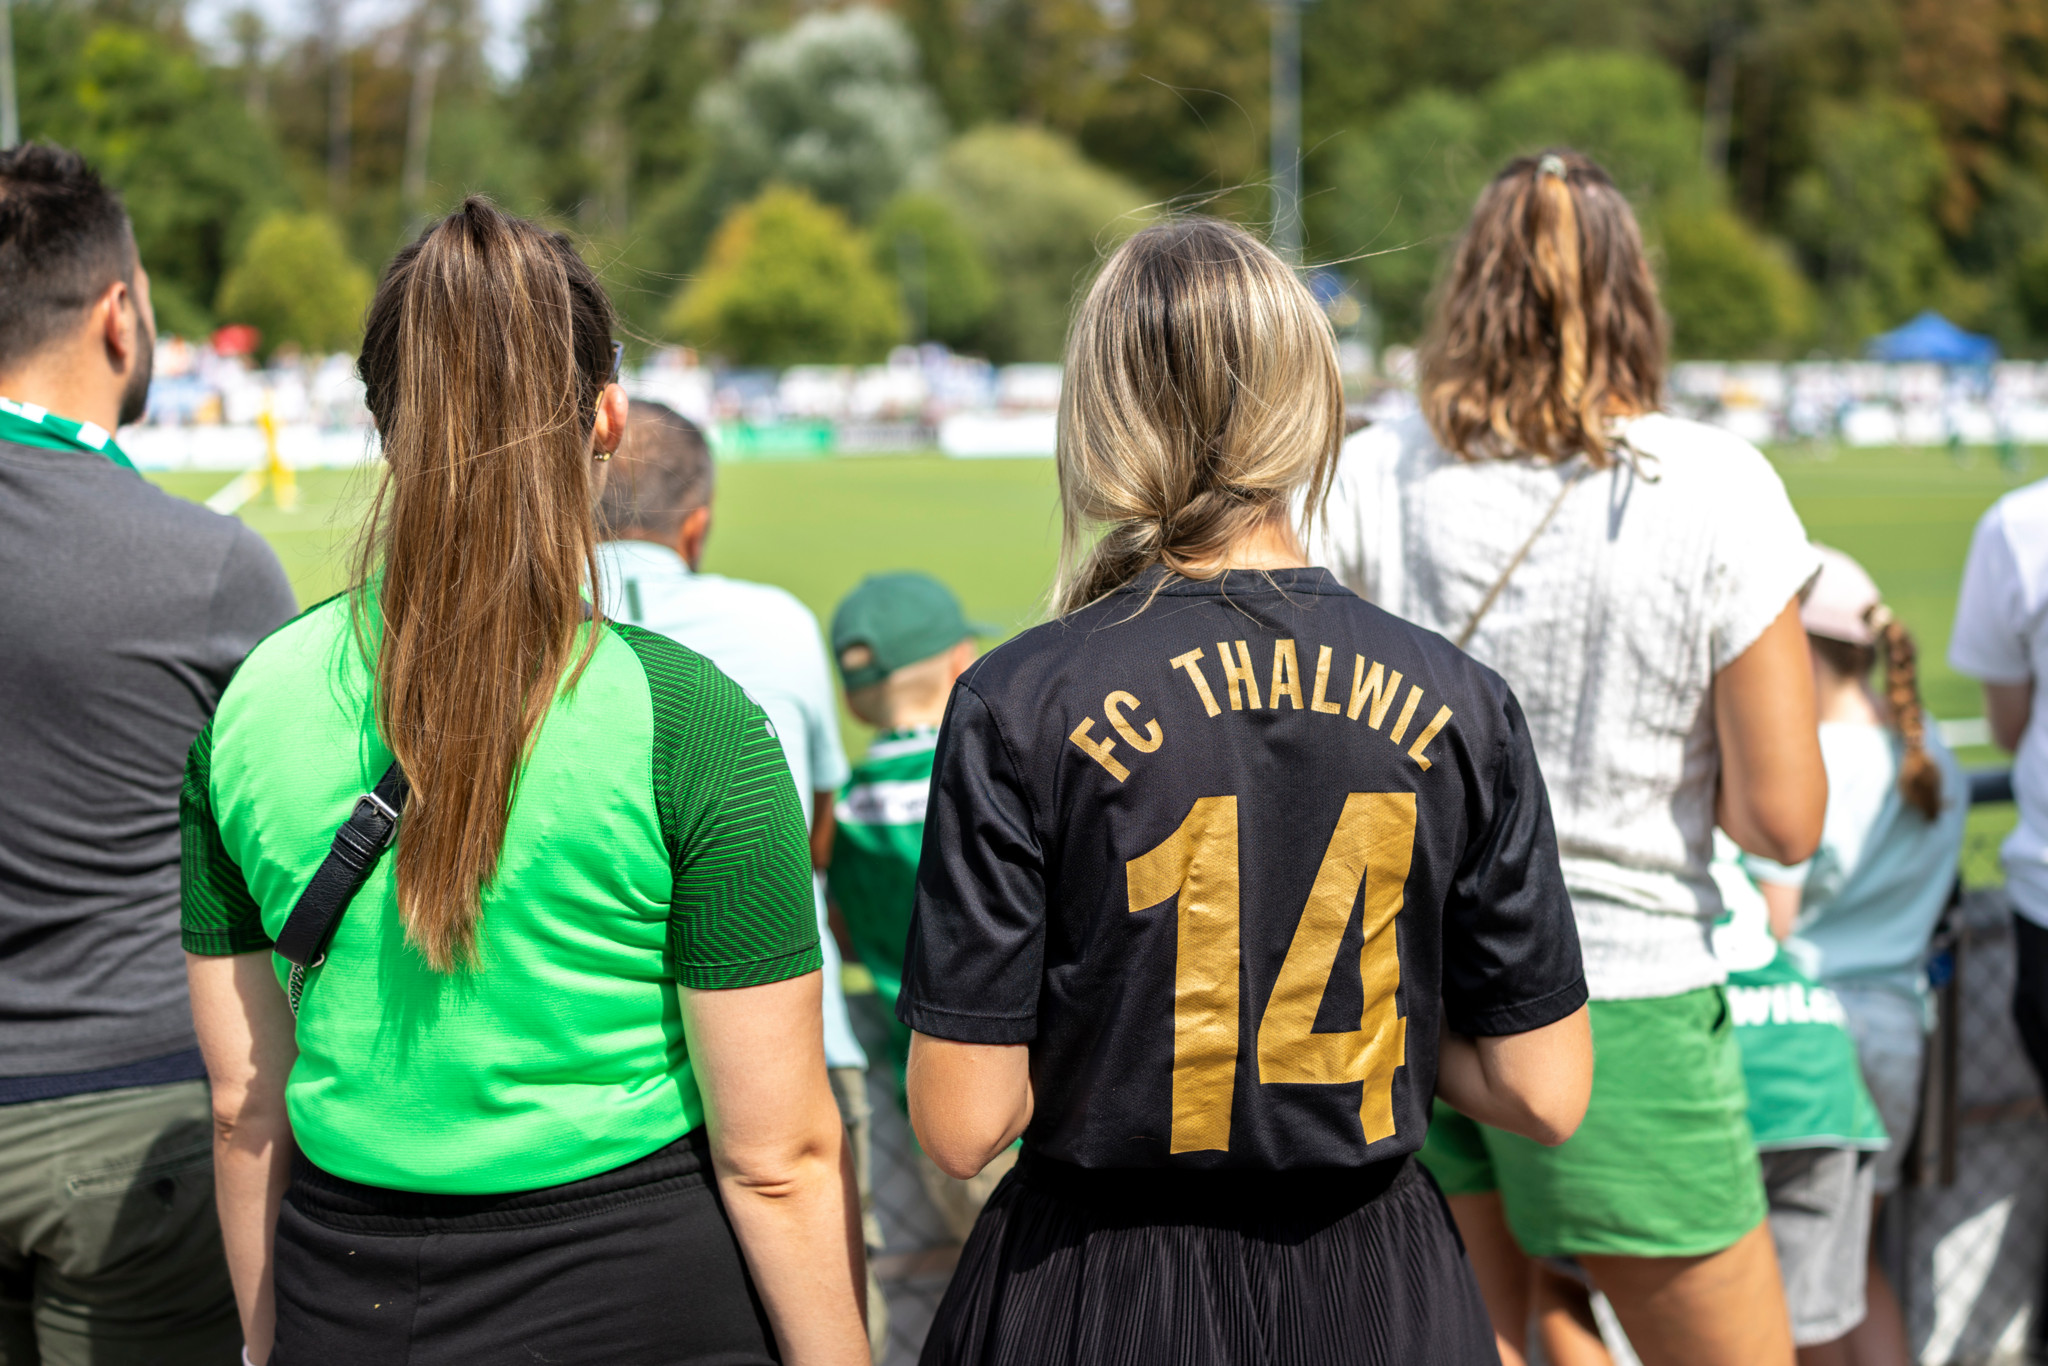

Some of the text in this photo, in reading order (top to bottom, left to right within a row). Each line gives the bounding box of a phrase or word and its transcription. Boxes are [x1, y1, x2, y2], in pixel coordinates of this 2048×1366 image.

[1068, 638, 1453, 783] FC THALWIL
[1125, 791, 1417, 1155] 14
